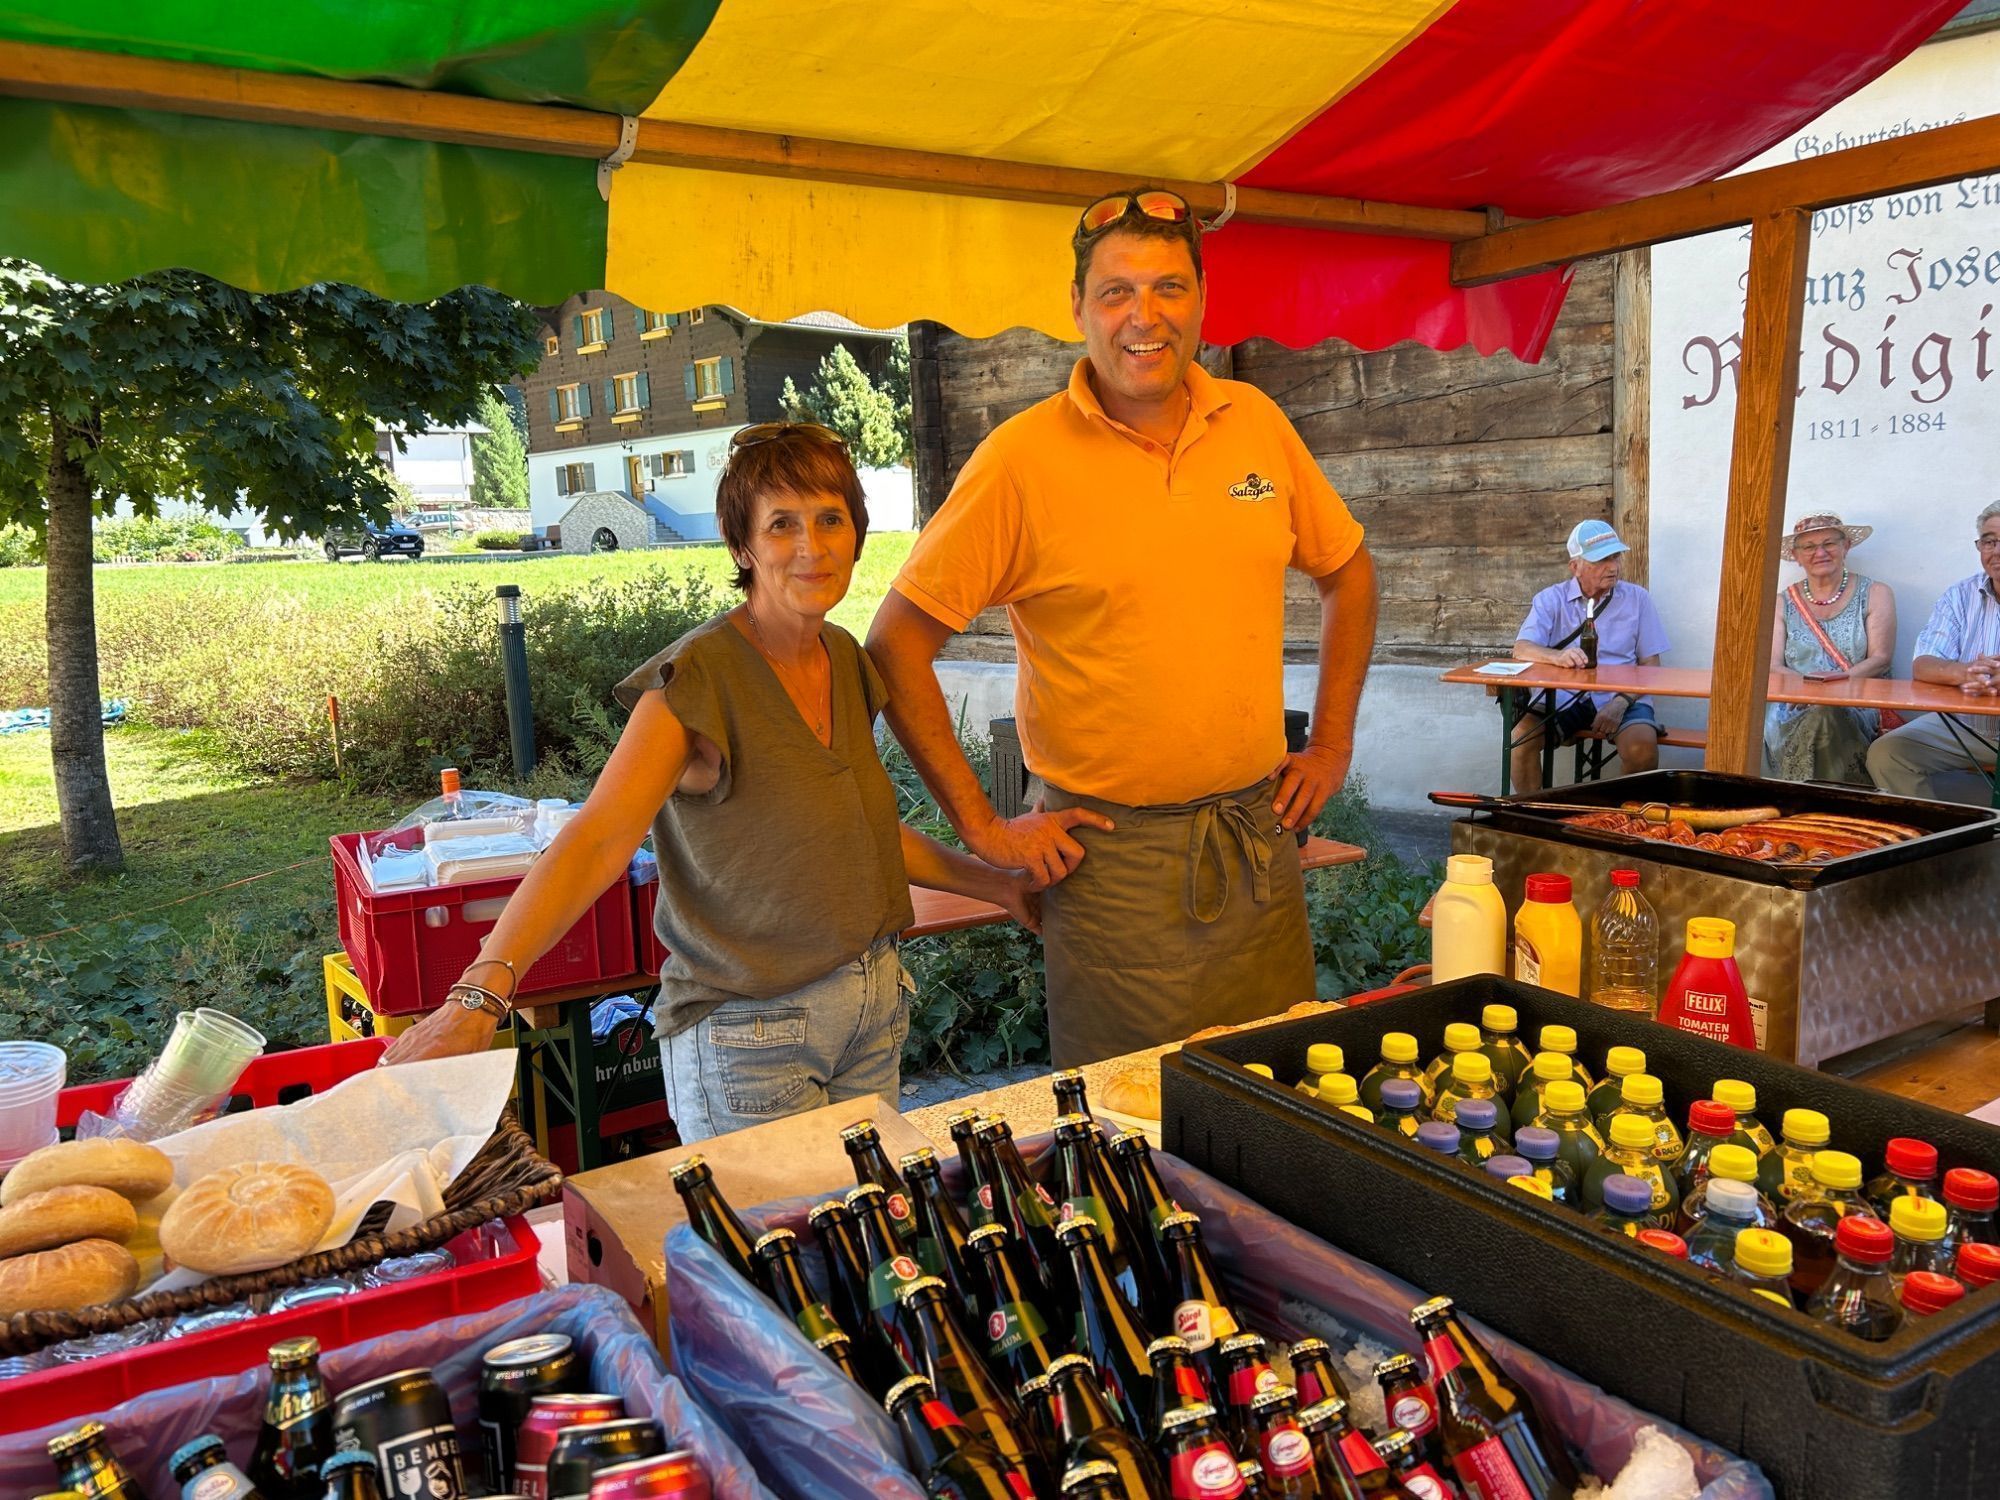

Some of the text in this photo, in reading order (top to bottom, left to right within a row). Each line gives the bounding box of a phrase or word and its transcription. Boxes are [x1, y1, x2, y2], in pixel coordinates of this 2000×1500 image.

[1888, 191, 1943, 220] von
[1682, 303, 1995, 410] Rdigi
[1807, 418, 1861, 441] 1811
[1887, 412, 1947, 435] 1884
[1688, 994, 1723, 1012] FELIX
[1678, 1016, 1730, 1034] TOMATEN
